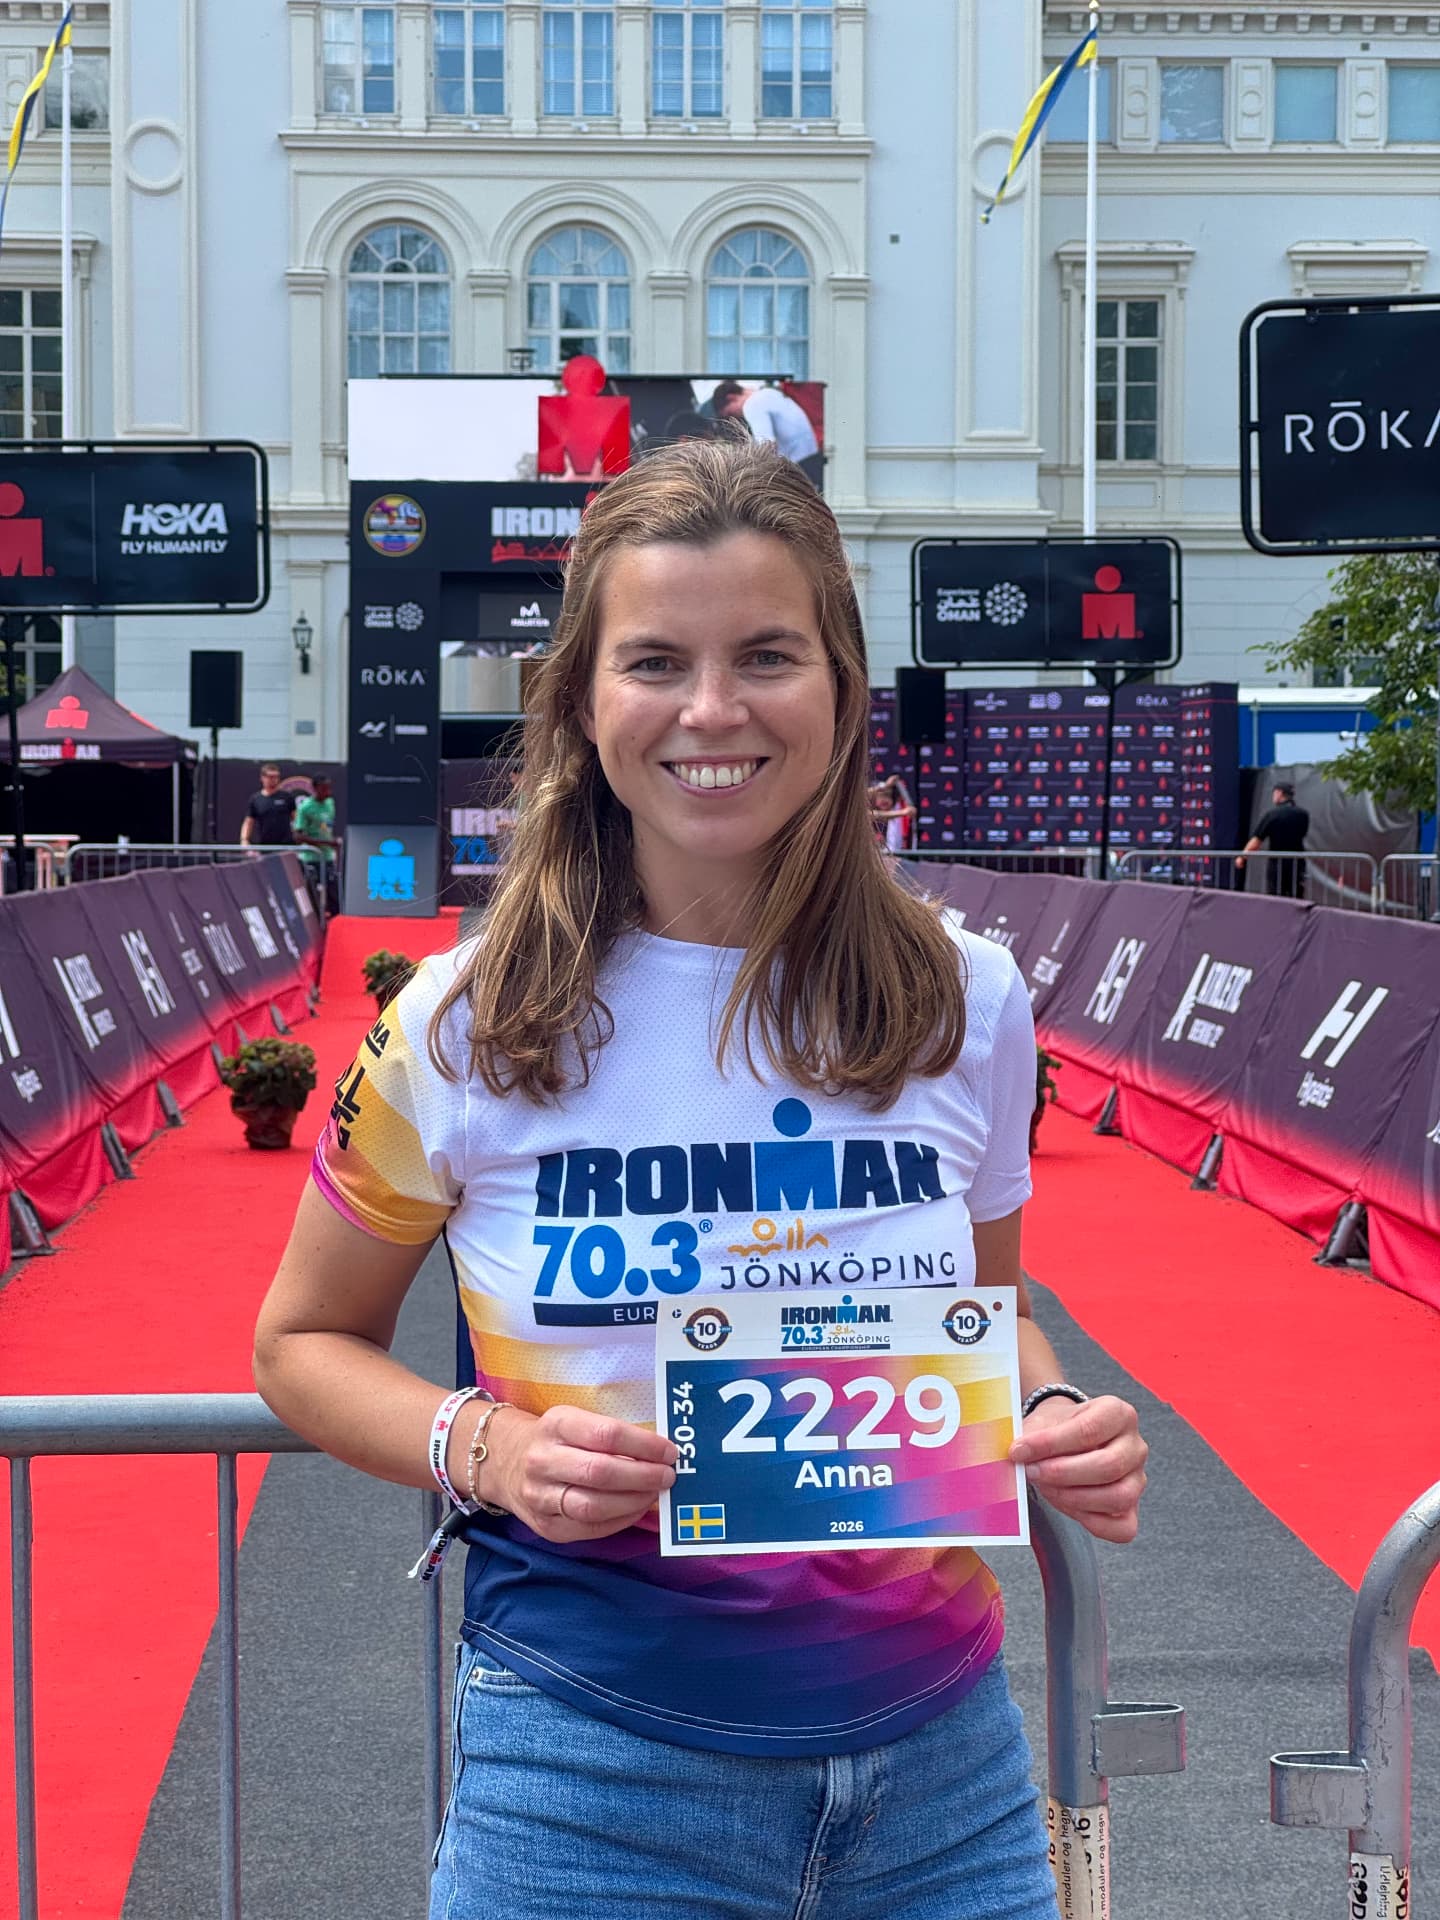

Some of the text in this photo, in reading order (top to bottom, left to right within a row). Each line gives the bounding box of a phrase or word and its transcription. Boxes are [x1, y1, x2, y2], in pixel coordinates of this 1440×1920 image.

[121, 503, 229, 535] HOKA
[492, 506, 583, 537] IRON
[121, 540, 228, 554] FLY HUMAN FLY
[937, 609, 981, 622] OMAN
[535, 1097, 947, 1218] IRONMAN
[721, 1250, 956, 1291] JÖNKÖPING
[781, 1294, 890, 1325] IRONMAN
[956, 1315, 976, 1330] 10
[697, 1322, 717, 1336] 10
[781, 1325, 823, 1345] 70.3
[827, 1334, 890, 1344] JÖNKÖPING
[672, 1381, 697, 1474] F30-34
[718, 1374, 961, 1454] 2229
[794, 1460, 893, 1489] Anna
[829, 1520, 864, 1533] 2026
[1060, 1808, 1071, 1838] hegn
[1062, 1842, 1072, 1857] og
[1061, 1860, 1072, 1908] moduler
[1377, 1866, 1391, 1918] Udlejning
